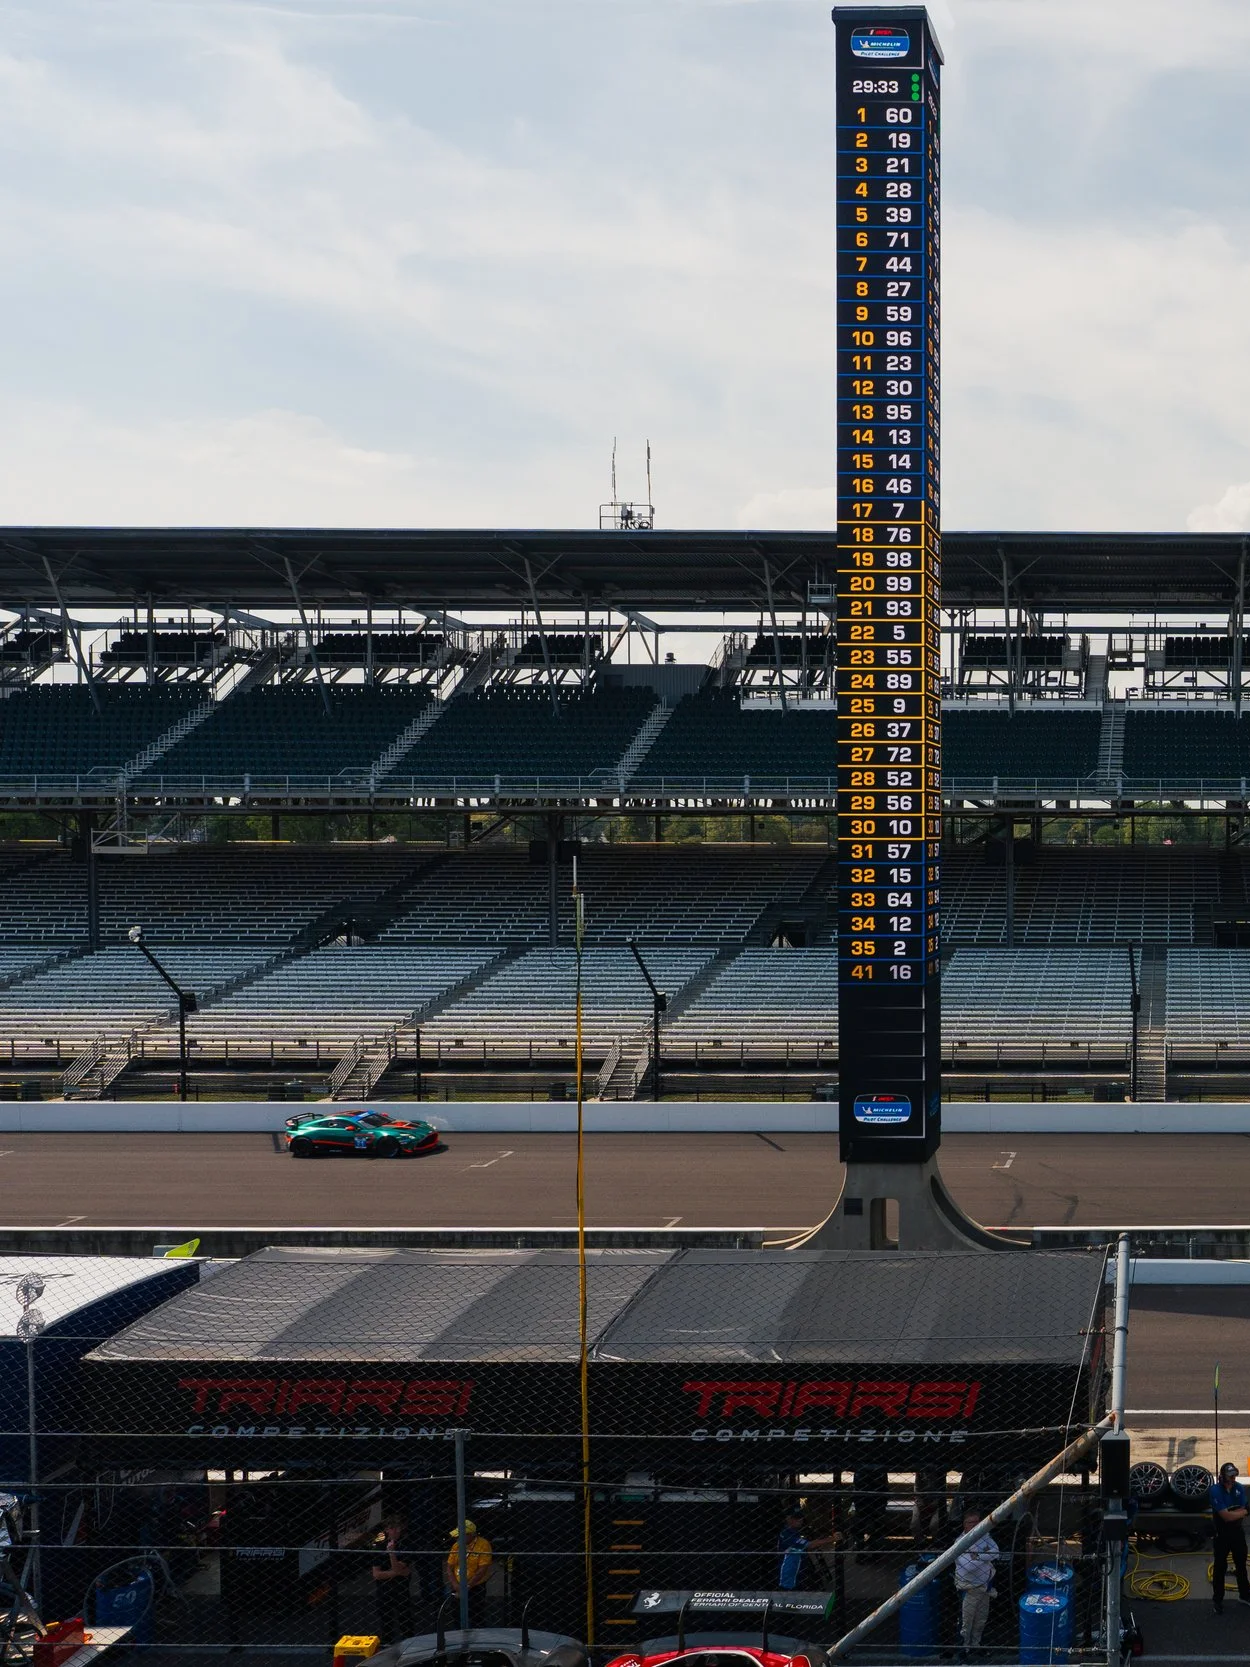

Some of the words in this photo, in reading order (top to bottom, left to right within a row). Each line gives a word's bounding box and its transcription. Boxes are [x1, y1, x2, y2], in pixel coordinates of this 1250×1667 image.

[853, 80, 899, 93] 29:33
[857, 108, 866, 122] 1
[885, 108, 913, 123] 60
[855, 133, 868, 147] 2
[888, 133, 911, 148] 19
[855, 158, 868, 172] 3
[886, 158, 909, 172] 21
[855, 183, 869, 197] 4
[886, 183, 912, 197] 28
[856, 208, 868, 222] 5
[885, 208, 912, 222] 39
[855, 232, 869, 246] 6
[886, 232, 909, 247] 71
[855, 257, 868, 271] 7
[885, 257, 913, 272] 44
[856, 282, 869, 296] 8
[886, 282, 911, 296] 27
[856, 307, 869, 320] 9
[886, 306, 912, 321] 59
[852, 331, 875, 345] 10
[886, 331, 912, 346] 96
[852, 356, 872, 369] 11
[886, 356, 912, 370] 23
[852, 381, 874, 394] 12
[886, 381, 913, 395] 30
[852, 405, 874, 419] 13
[886, 405, 912, 419] 95
[852, 430, 875, 444] 14
[888, 430, 911, 444] 13
[852, 454, 874, 468] 15
[888, 454, 912, 468] 14
[852, 479, 874, 492] 16
[885, 479, 912, 493] 46
[852, 503, 873, 517] 17
[892, 503, 905, 518] 7
[852, 528, 874, 542] 18
[886, 528, 912, 542] 76
[852, 552, 874, 566] 19
[886, 552, 912, 567] 98
[850, 577, 875, 591] 20
[886, 577, 912, 591] 99
[850, 601, 873, 615] 21
[886, 601, 912, 615] 93
[850, 626, 875, 639] 22
[893, 626, 906, 640] 5
[850, 650, 875, 664] 23
[886, 650, 912, 664] 55
[850, 674, 875, 688] 24
[886, 674, 912, 689] 89
[850, 699, 875, 713] 25
[893, 699, 906, 713] 9
[850, 723, 875, 737] 26
[887, 723, 912, 737] 37
[851, 748, 874, 761] 27
[887, 747, 912, 761] 72
[850, 772, 876, 785] 28
[887, 772, 912, 786] 52
[850, 796, 876, 810] 29
[887, 796, 912, 810] 56
[850, 820, 876, 834] 30
[889, 820, 912, 834] 10
[851, 845, 873, 858] 31
[887, 844, 912, 858] 57
[851, 869, 876, 882] 32
[889, 869, 912, 882] 15
[851, 893, 876, 906] 33
[887, 893, 913, 907] 64
[851, 917, 876, 930] 34
[889, 917, 912, 931] 12
[851, 941, 876, 955] 35
[893, 941, 906, 955] 2
[851, 966, 873, 978] 41
[889, 965, 912, 979] 16
[178, 1379, 476, 1416] TRIARSI
[682, 1381, 982, 1418] TRIARSI
[691, 1429, 969, 1443] COMPETIZIONE
